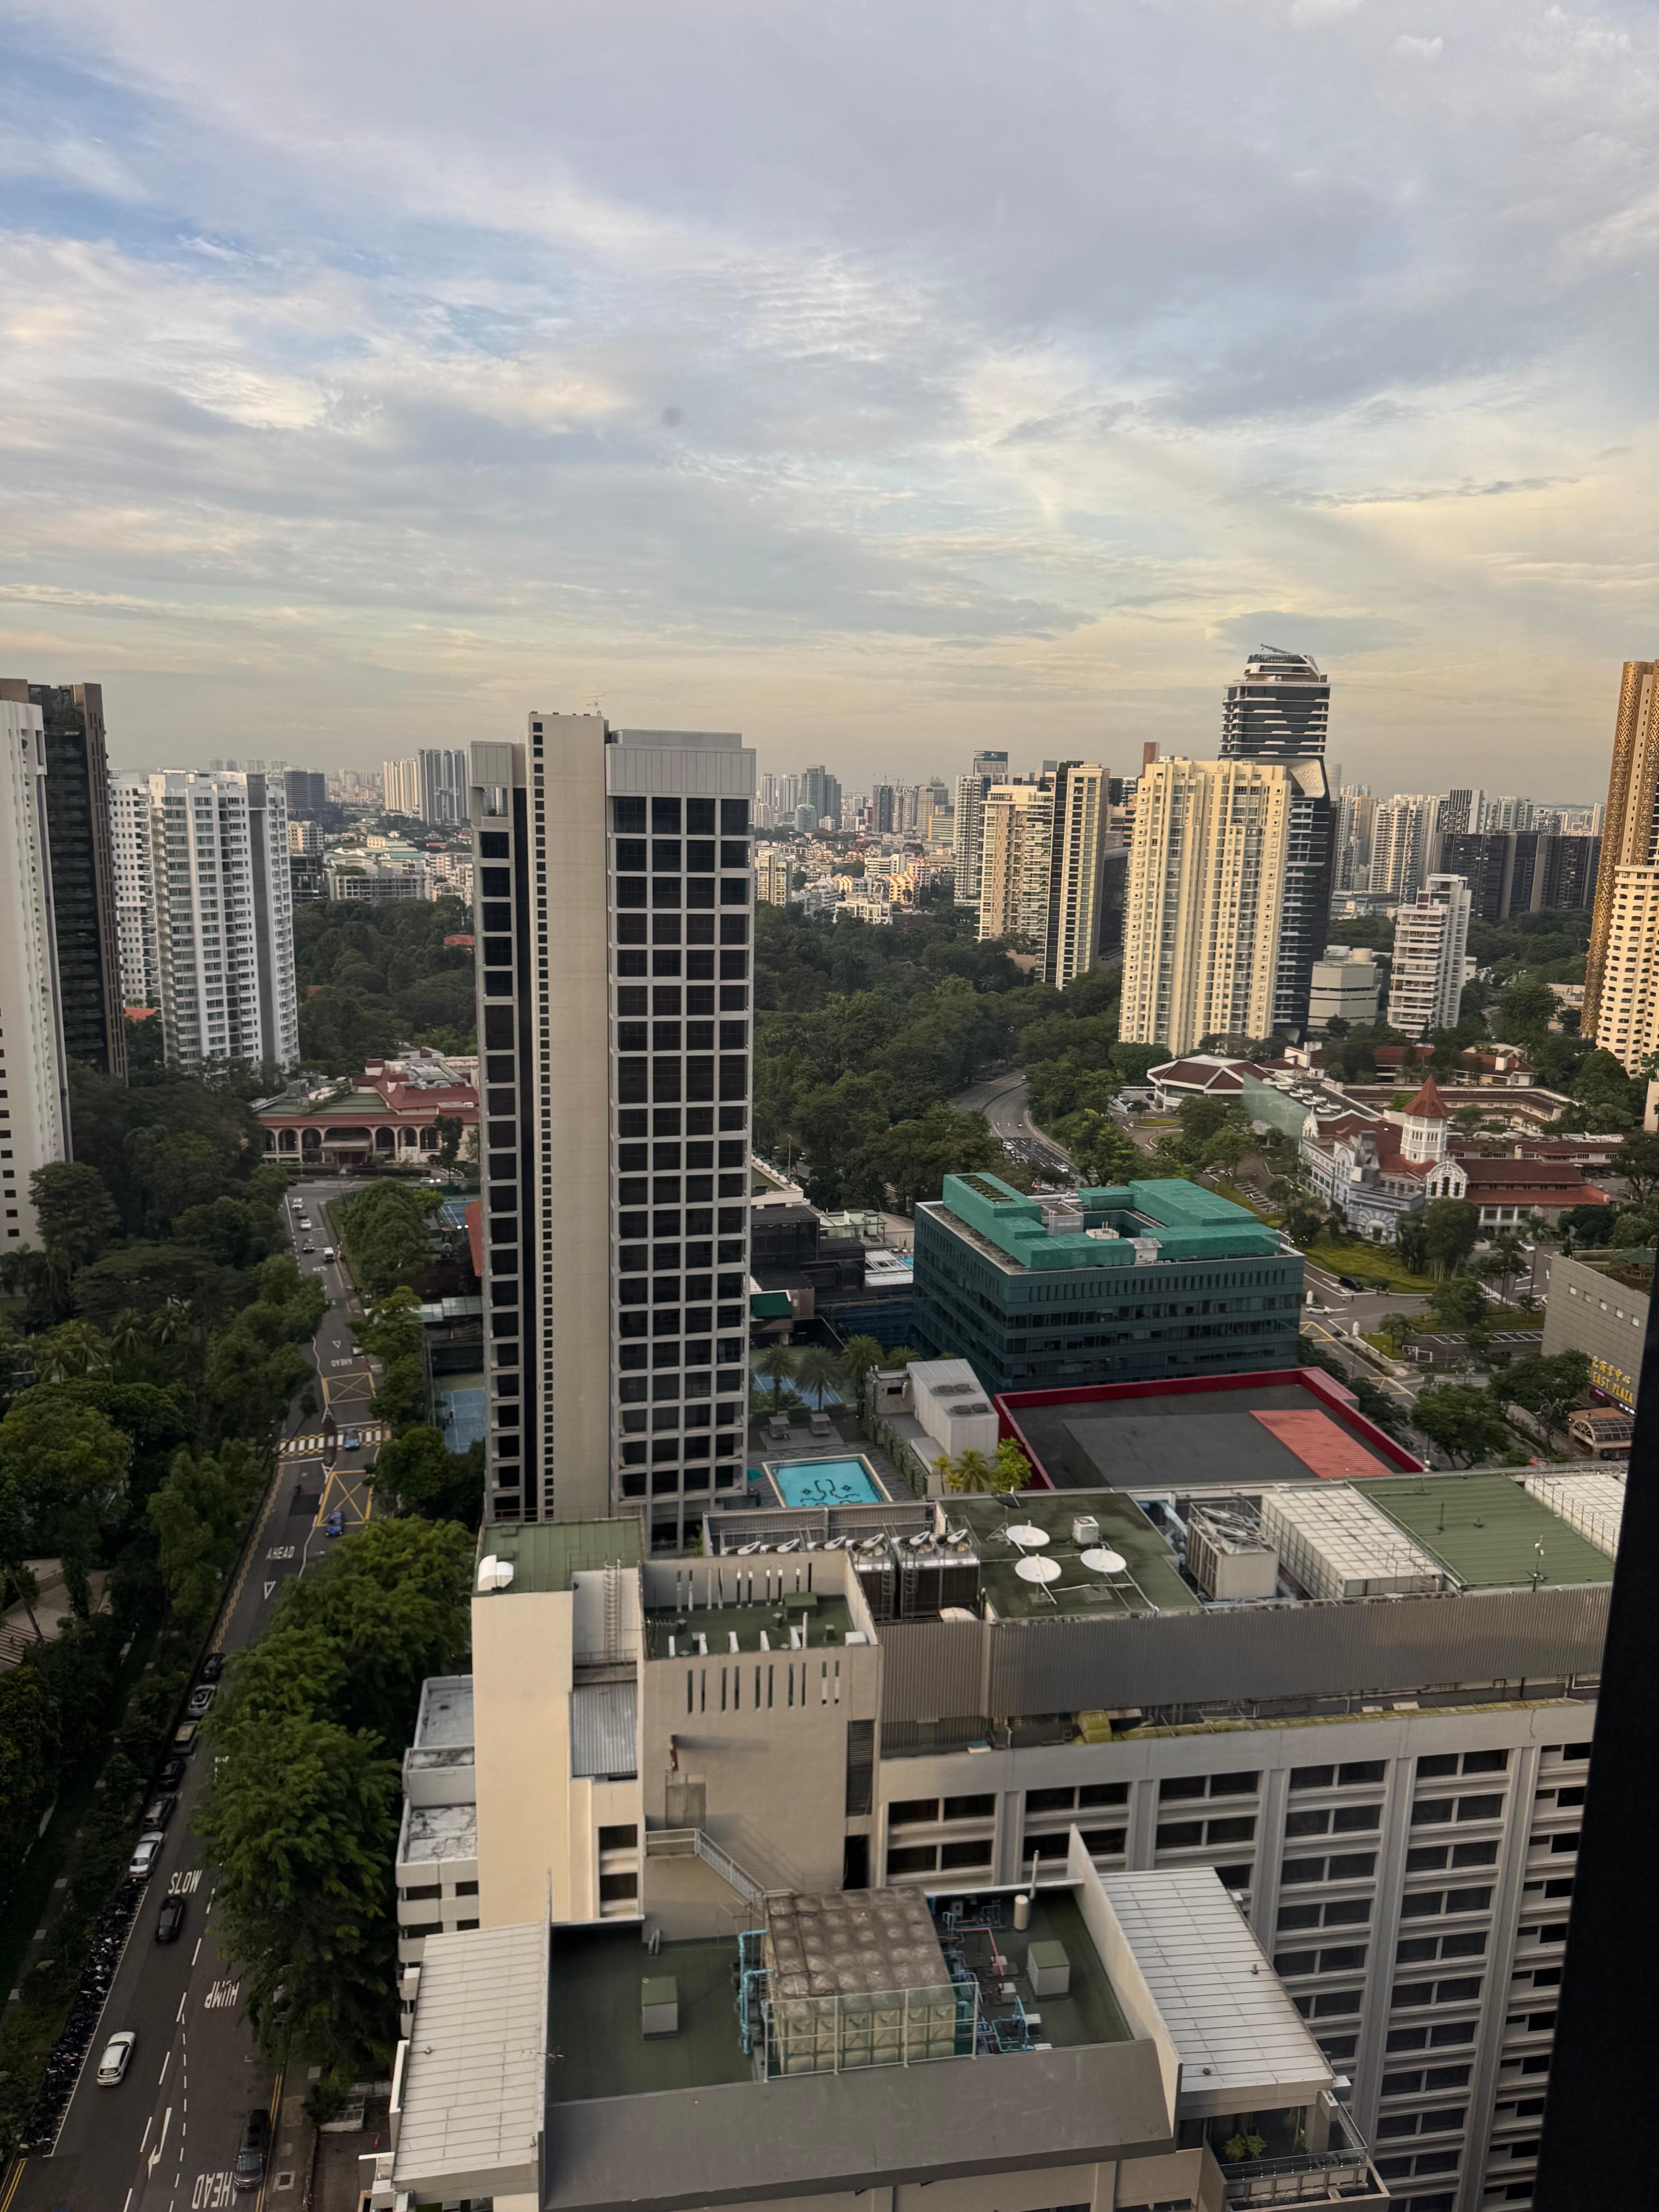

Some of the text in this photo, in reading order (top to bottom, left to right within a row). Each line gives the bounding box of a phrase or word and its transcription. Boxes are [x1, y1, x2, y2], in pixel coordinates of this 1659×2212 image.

[1592, 1371, 1610, 1390] EAST
[1612, 1382, 1633, 1404] PLAZA
[264, 1546, 295, 1560] AHEAD
[168, 1870, 203, 1894] SLOW
[204, 1980, 240, 2008] HUMP
